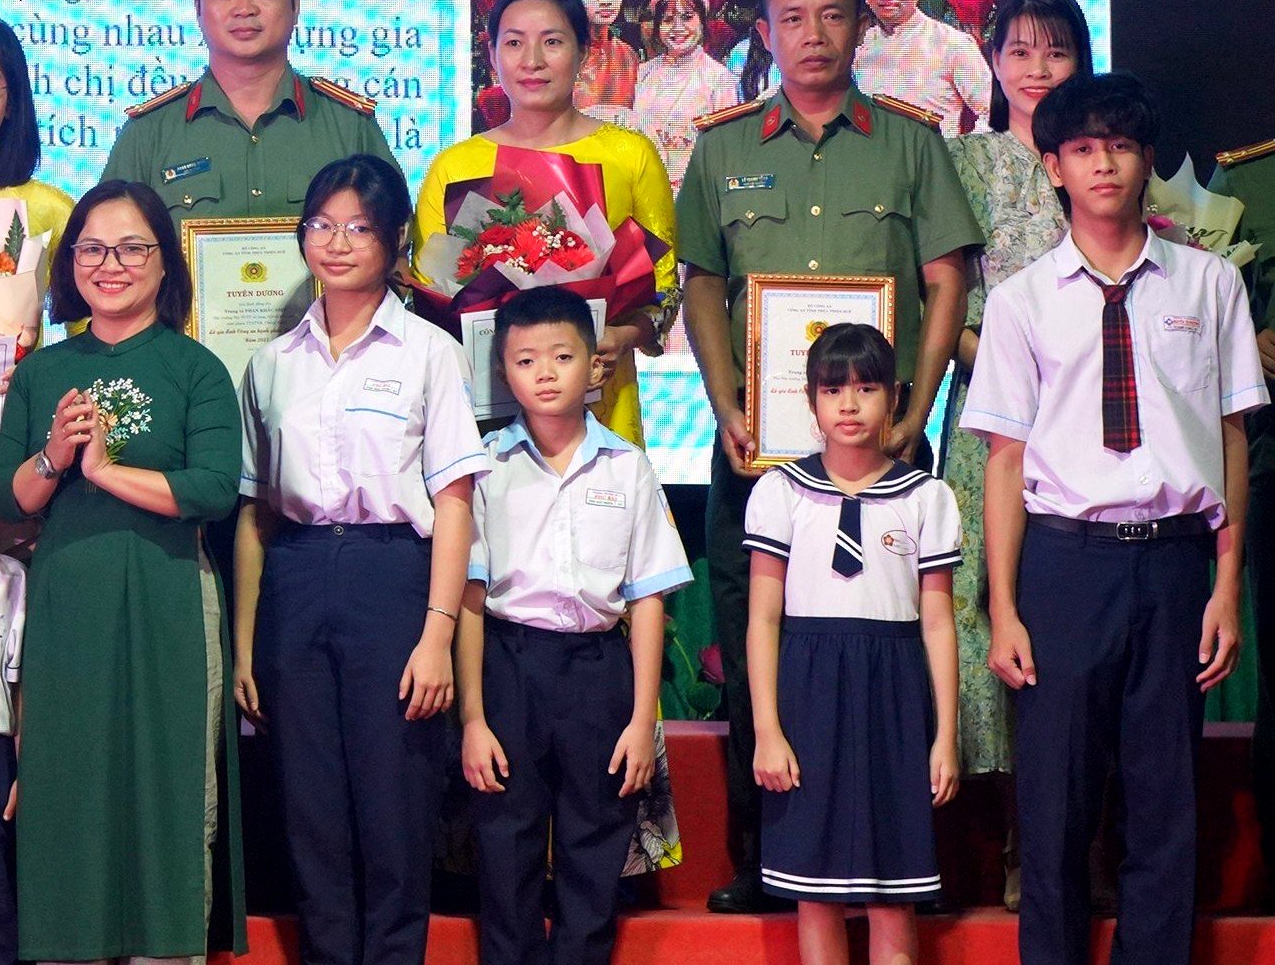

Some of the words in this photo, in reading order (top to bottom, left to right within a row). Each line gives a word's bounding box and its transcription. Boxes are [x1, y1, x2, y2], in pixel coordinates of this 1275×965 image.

[103, 15, 186, 47] nhau
[295, 26, 359, 58] ựng
[371, 16, 423, 58] gia
[64, 64, 116, 103] chị
[364, 67, 423, 99] cán
[395, 117, 423, 150] là
